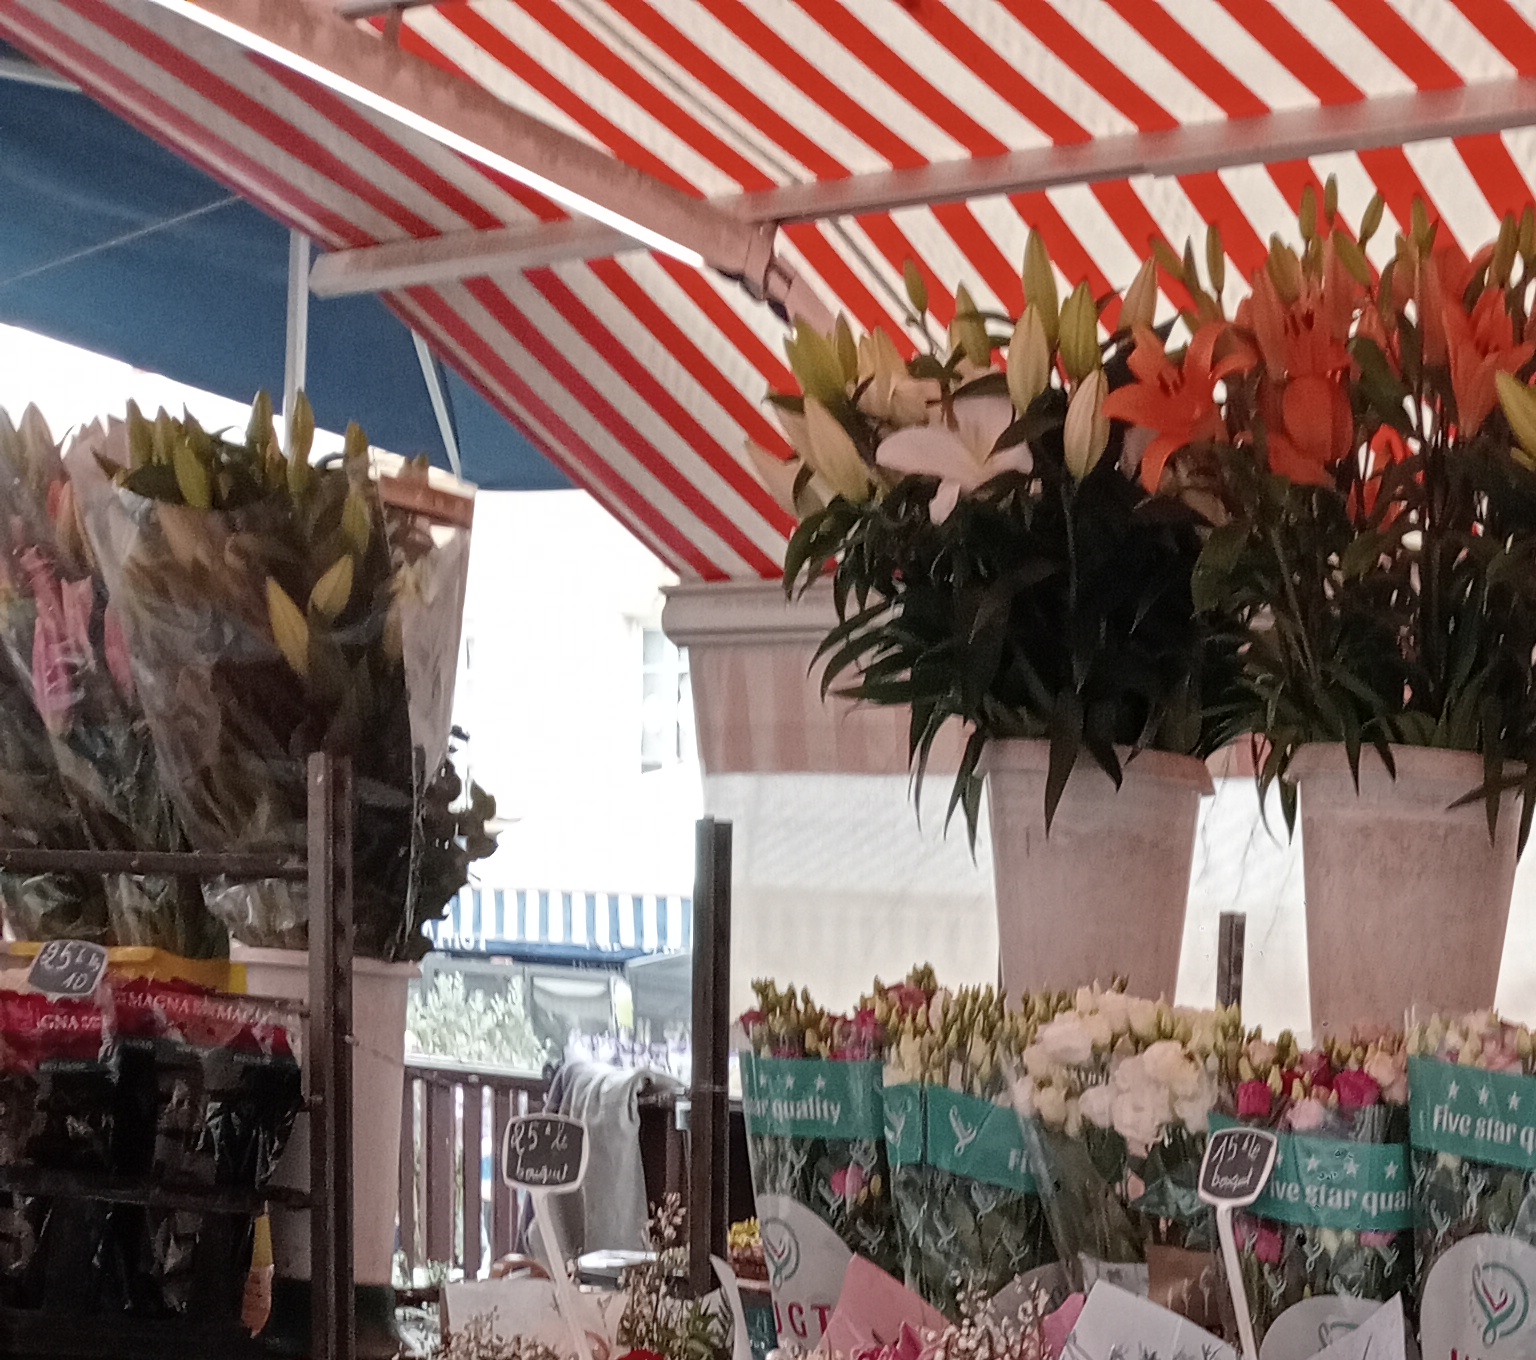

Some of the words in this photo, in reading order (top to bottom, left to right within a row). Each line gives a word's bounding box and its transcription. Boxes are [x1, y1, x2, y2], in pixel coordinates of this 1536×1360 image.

[772, 1096, 841, 1126] quality
[1432, 1102, 1472, 1136] Five
[1474, 1116, 1517, 1145] star
[1268, 1180, 1300, 1203] ive
[1304, 1183, 1358, 1211] star
[1361, 1188, 1413, 1218] qual
